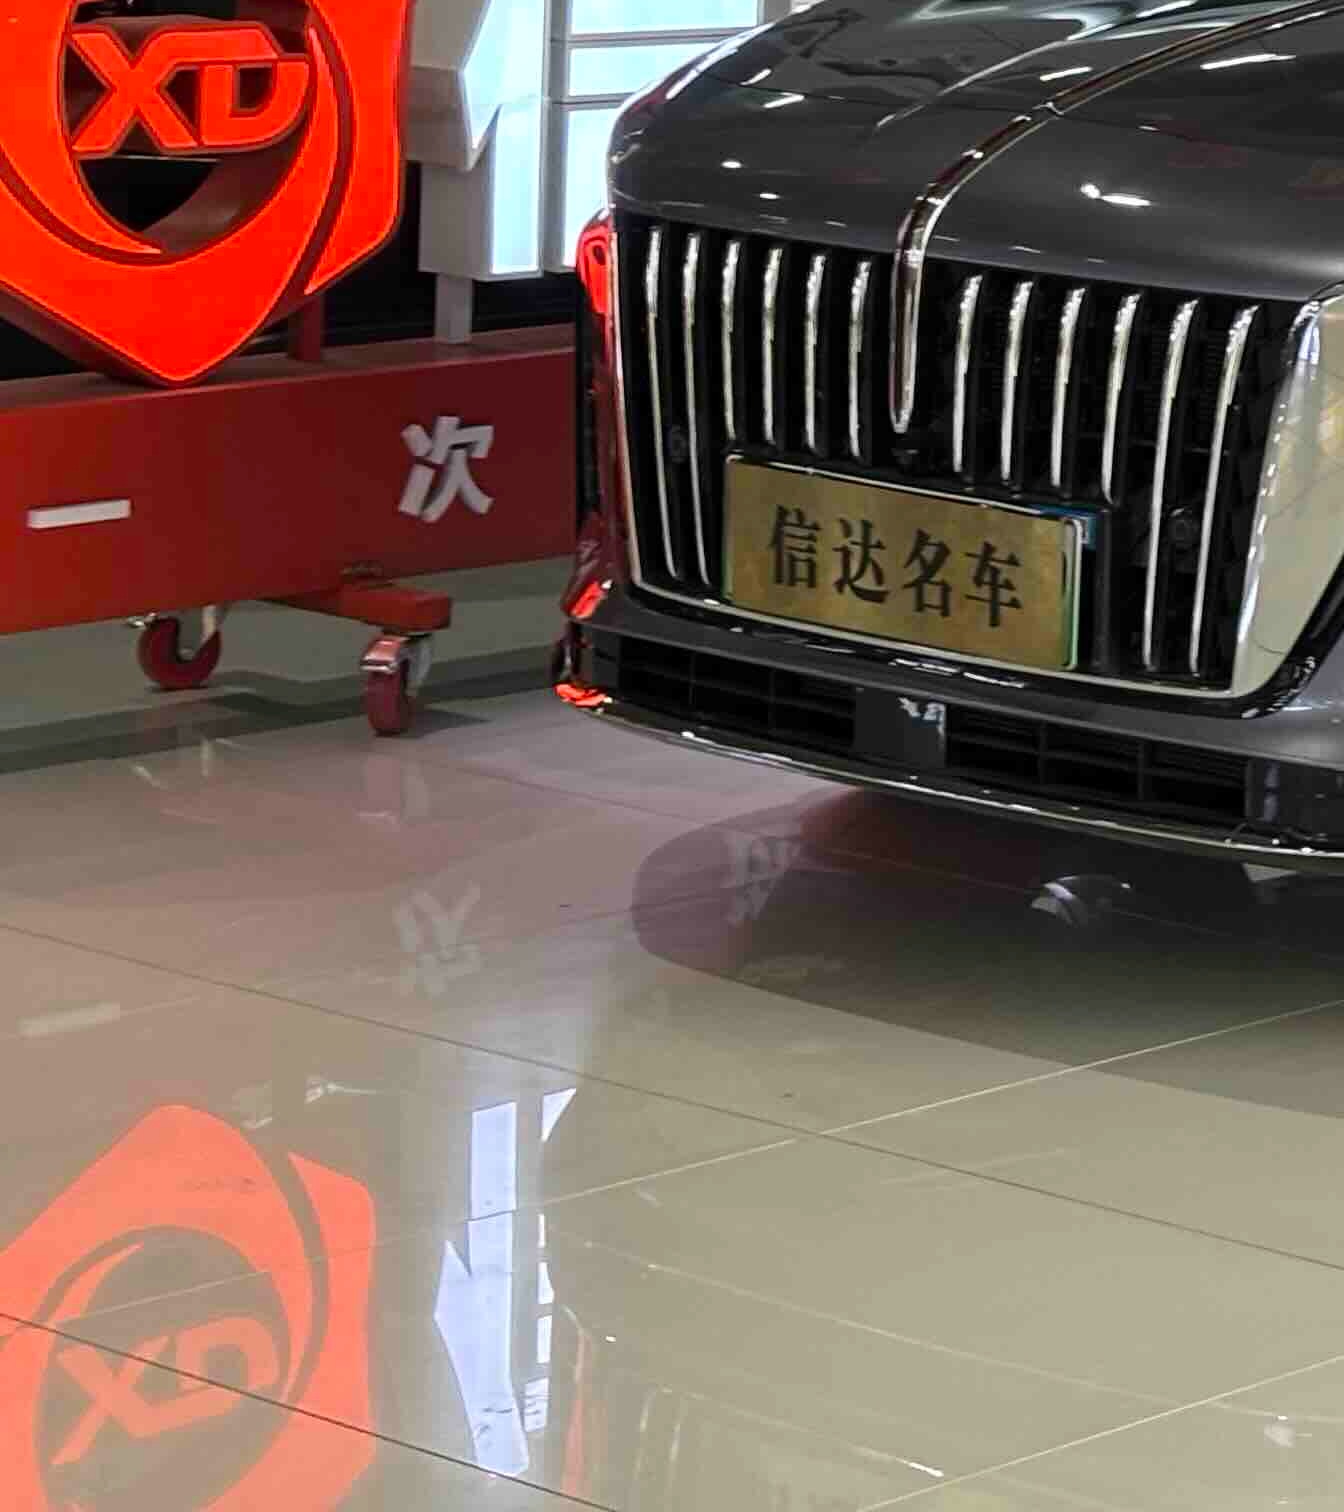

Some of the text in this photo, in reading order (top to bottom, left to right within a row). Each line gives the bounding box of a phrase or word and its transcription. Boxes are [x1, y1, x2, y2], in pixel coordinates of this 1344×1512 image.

[70, 23, 310, 158] XD
[769, 504, 1024, 628] 信达名车
